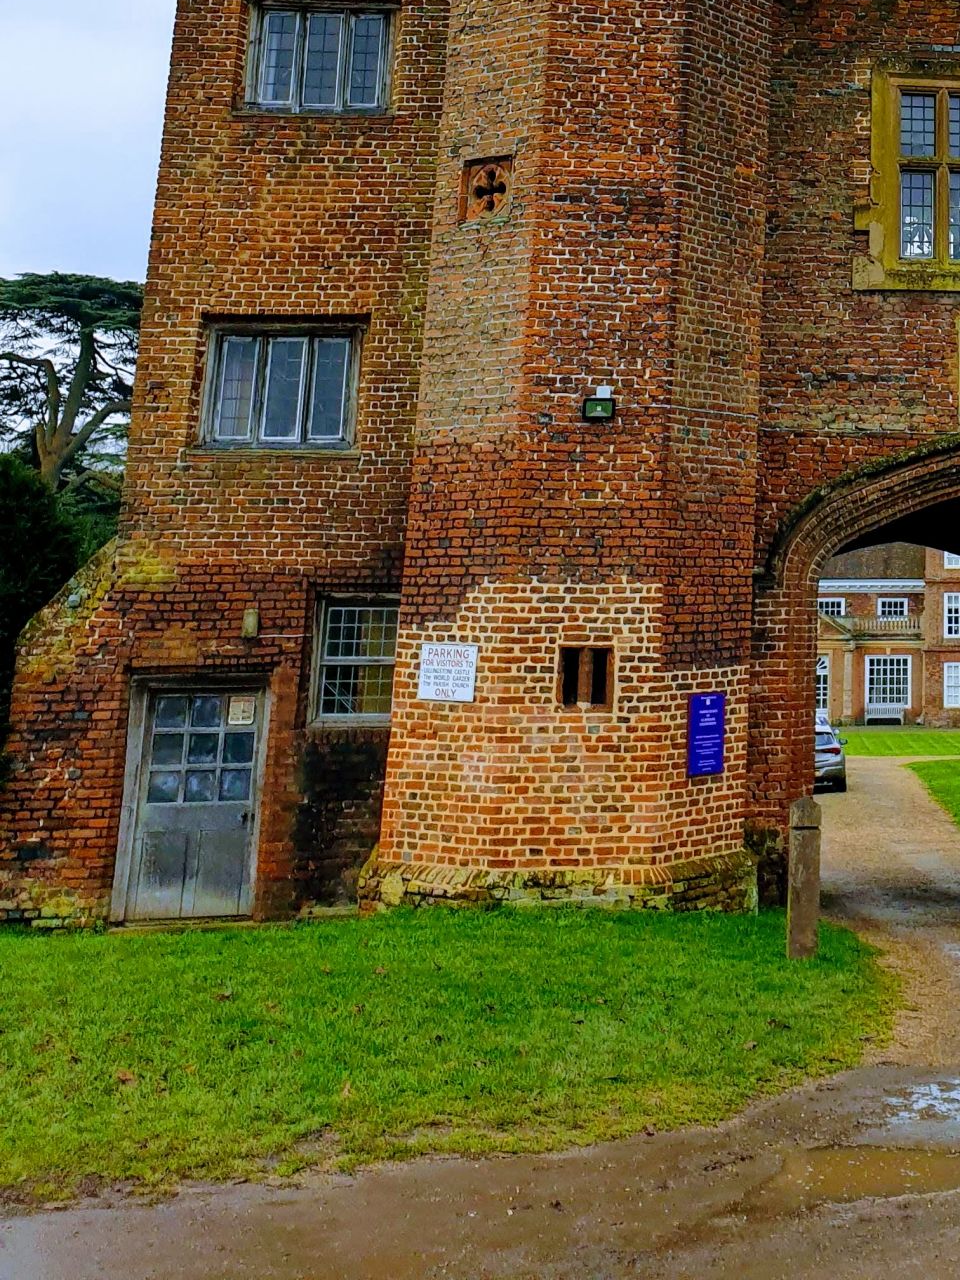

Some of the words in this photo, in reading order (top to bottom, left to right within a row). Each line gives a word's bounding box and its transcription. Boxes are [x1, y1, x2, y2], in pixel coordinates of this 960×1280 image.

[427, 647, 470, 659] PARKING
[422, 658, 434, 666] FOR
[436, 659, 464, 668] VISITORS
[465, 660, 474, 668] TO
[434, 687, 457, 698] ONLY
